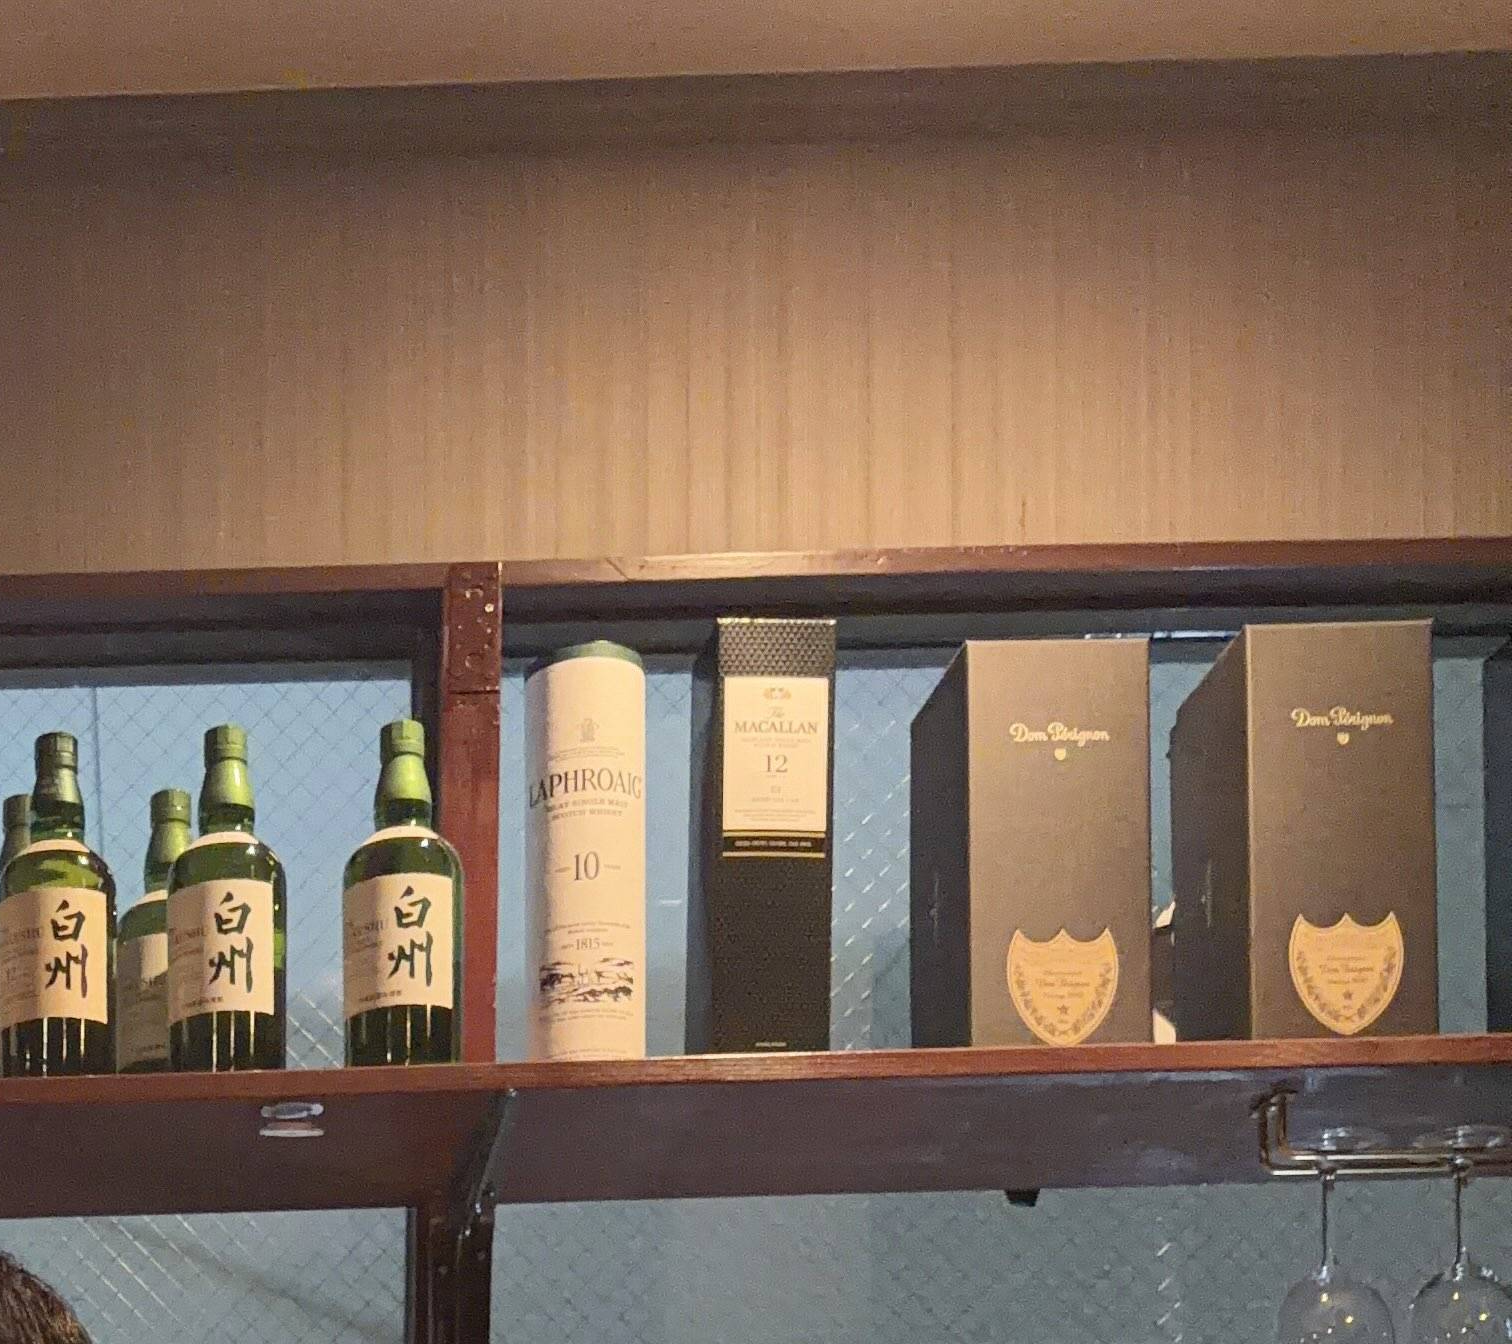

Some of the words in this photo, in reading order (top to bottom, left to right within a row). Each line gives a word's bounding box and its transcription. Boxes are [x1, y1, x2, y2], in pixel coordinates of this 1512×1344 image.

[734, 720, 818, 735] MACALLAN
[1291, 708, 1329, 727] Dom
[1009, 723, 1047, 742] Dom
[765, 754, 788, 774] 12
[573, 851, 600, 881] 10
[45, 899, 88, 998] 白州
[208, 891, 254, 994] 白州
[387, 886, 434, 987] 白州
